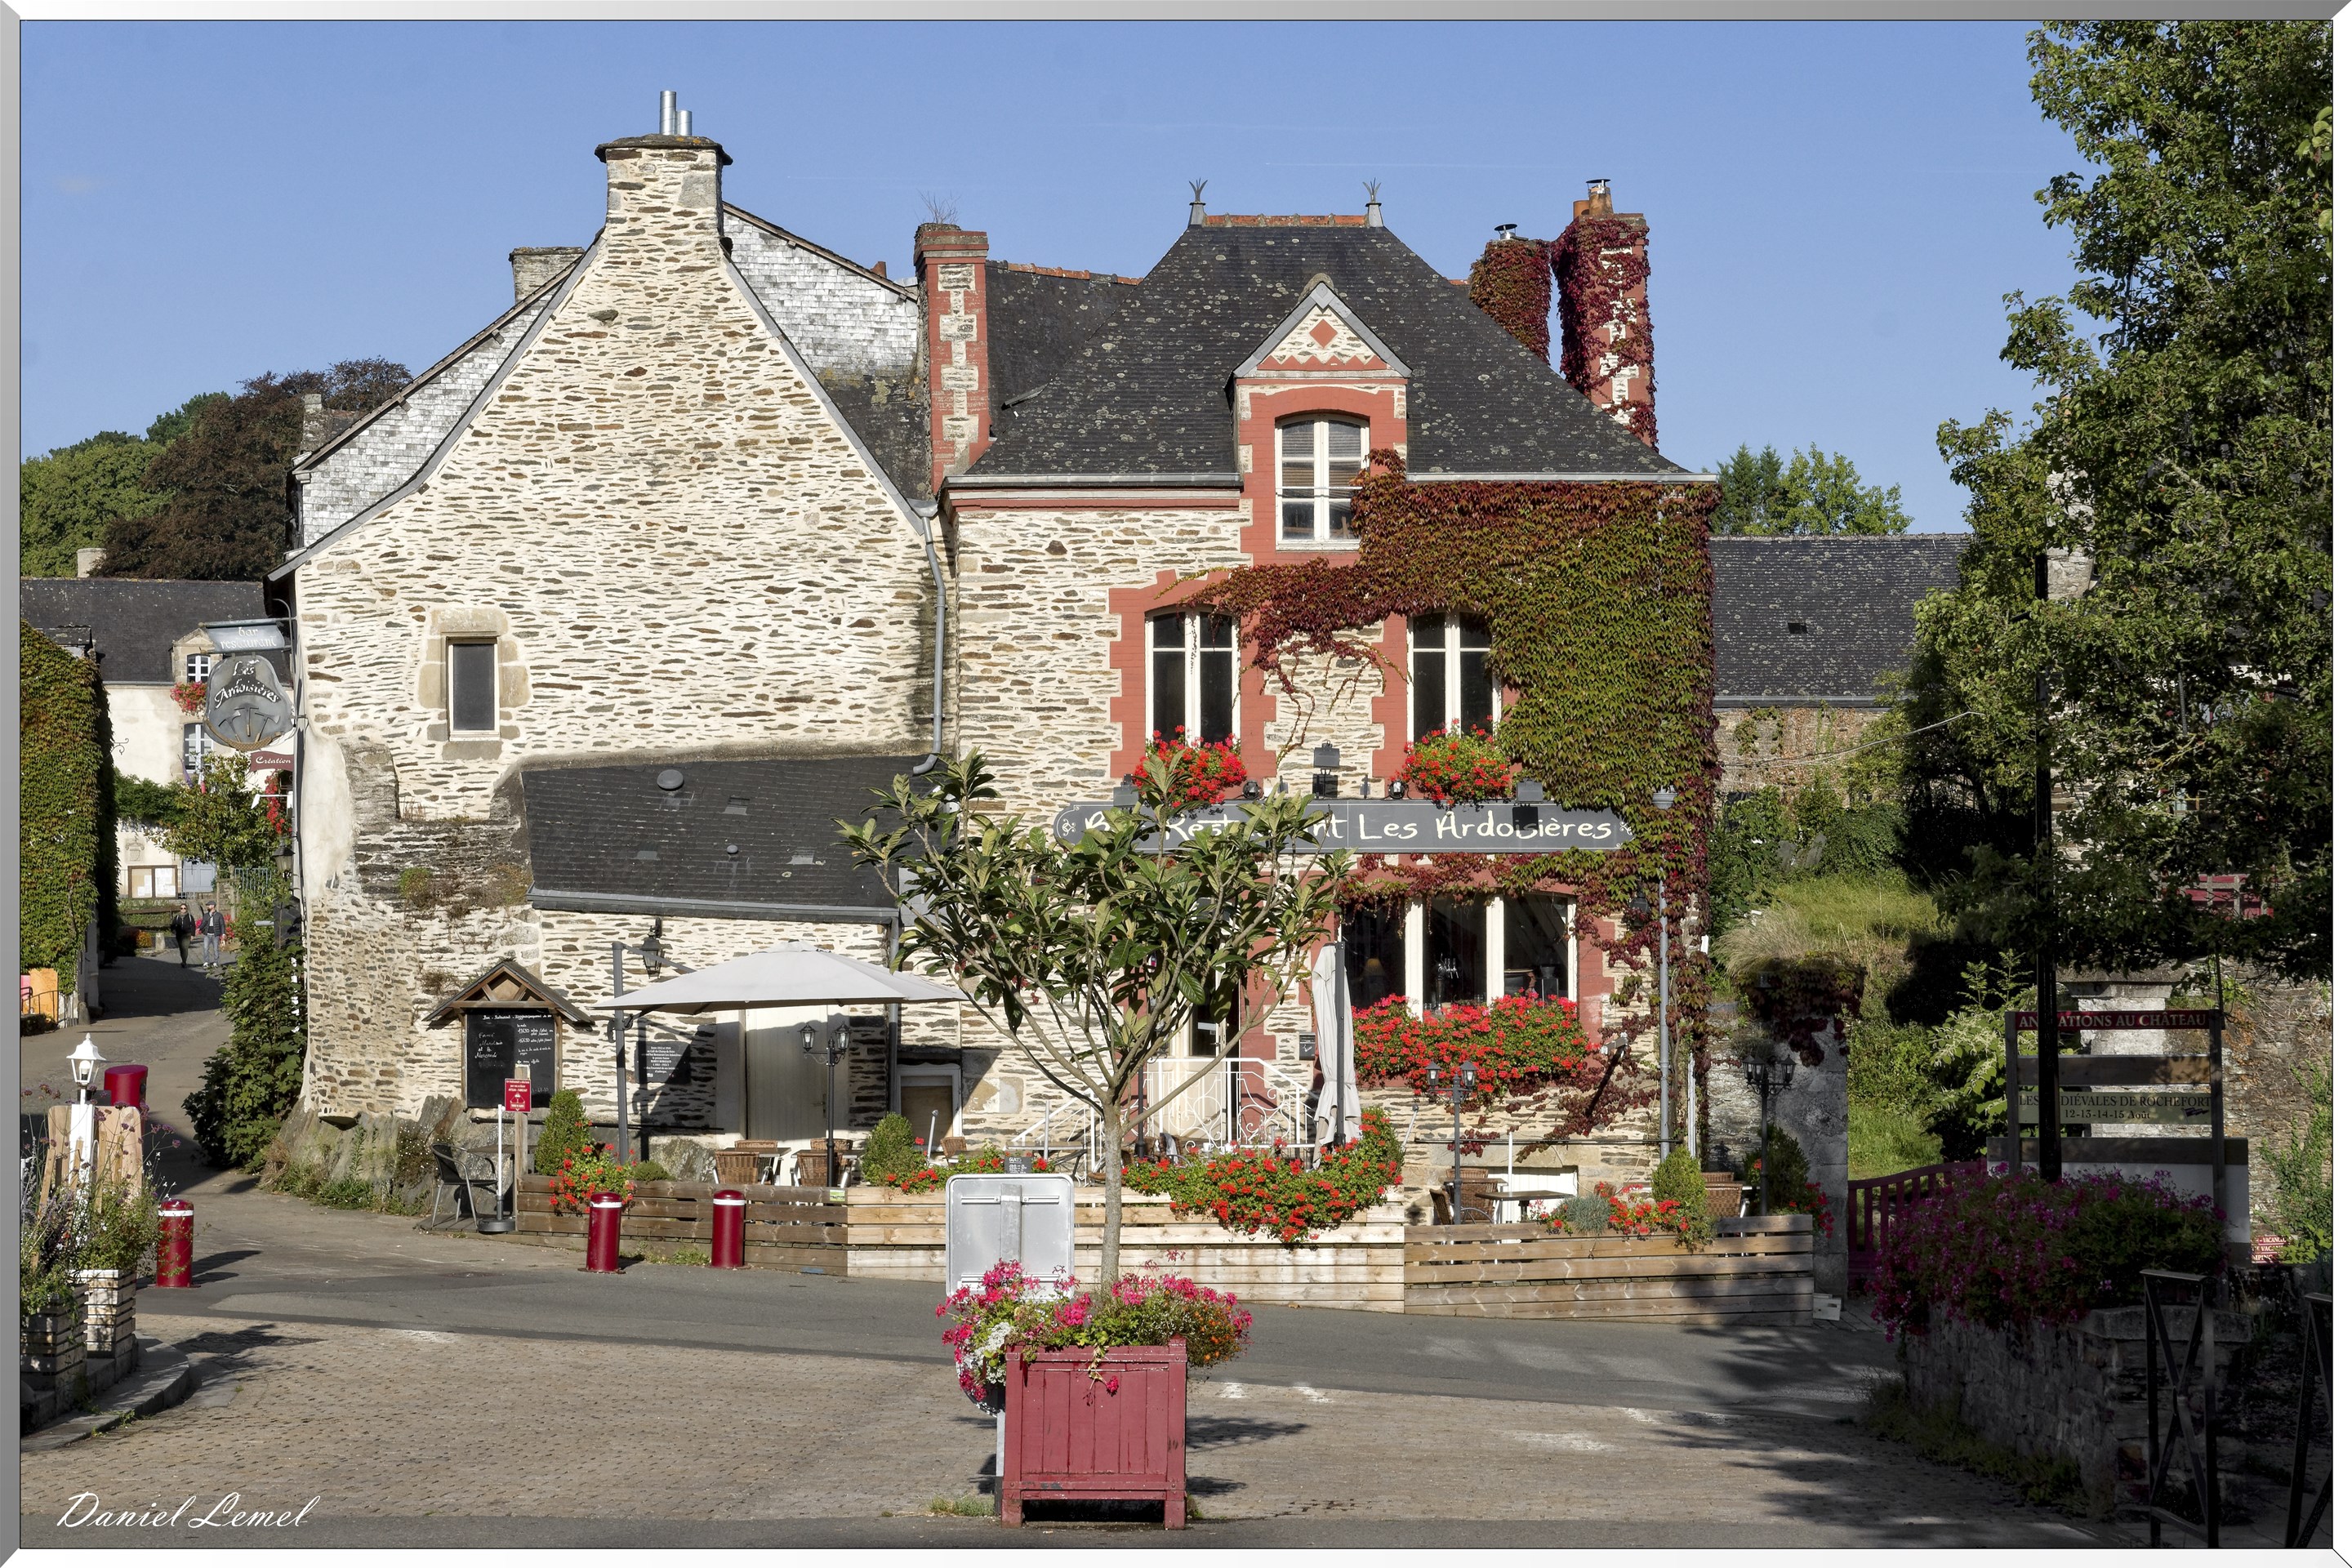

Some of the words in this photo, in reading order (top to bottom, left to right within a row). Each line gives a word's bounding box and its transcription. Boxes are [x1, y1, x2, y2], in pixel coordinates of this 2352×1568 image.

[238, 626, 258, 637] bar
[220, 636, 276, 649] restaurant
[1165, 811, 1348, 840] Restnt
[1359, 814, 1418, 840] Les
[1436, 810, 1611, 840] Ardoisières
[2019, 1014, 2113, 1027] ANATIONS
[2116, 1014, 2135, 1027] AU
[2139, 1011, 2206, 1027] CHÂTEAU
[2019, 1095, 2039, 1106] LES
[2060, 1093, 2117, 1107] DIÉVALES
[2119, 1096, 2136, 1107] DE
[2140, 1096, 2212, 1107] ROCHEFORT
[2065, 1109, 2125, 1120] 12-13-14-15
[2127, 1110, 2150, 1120] Août
